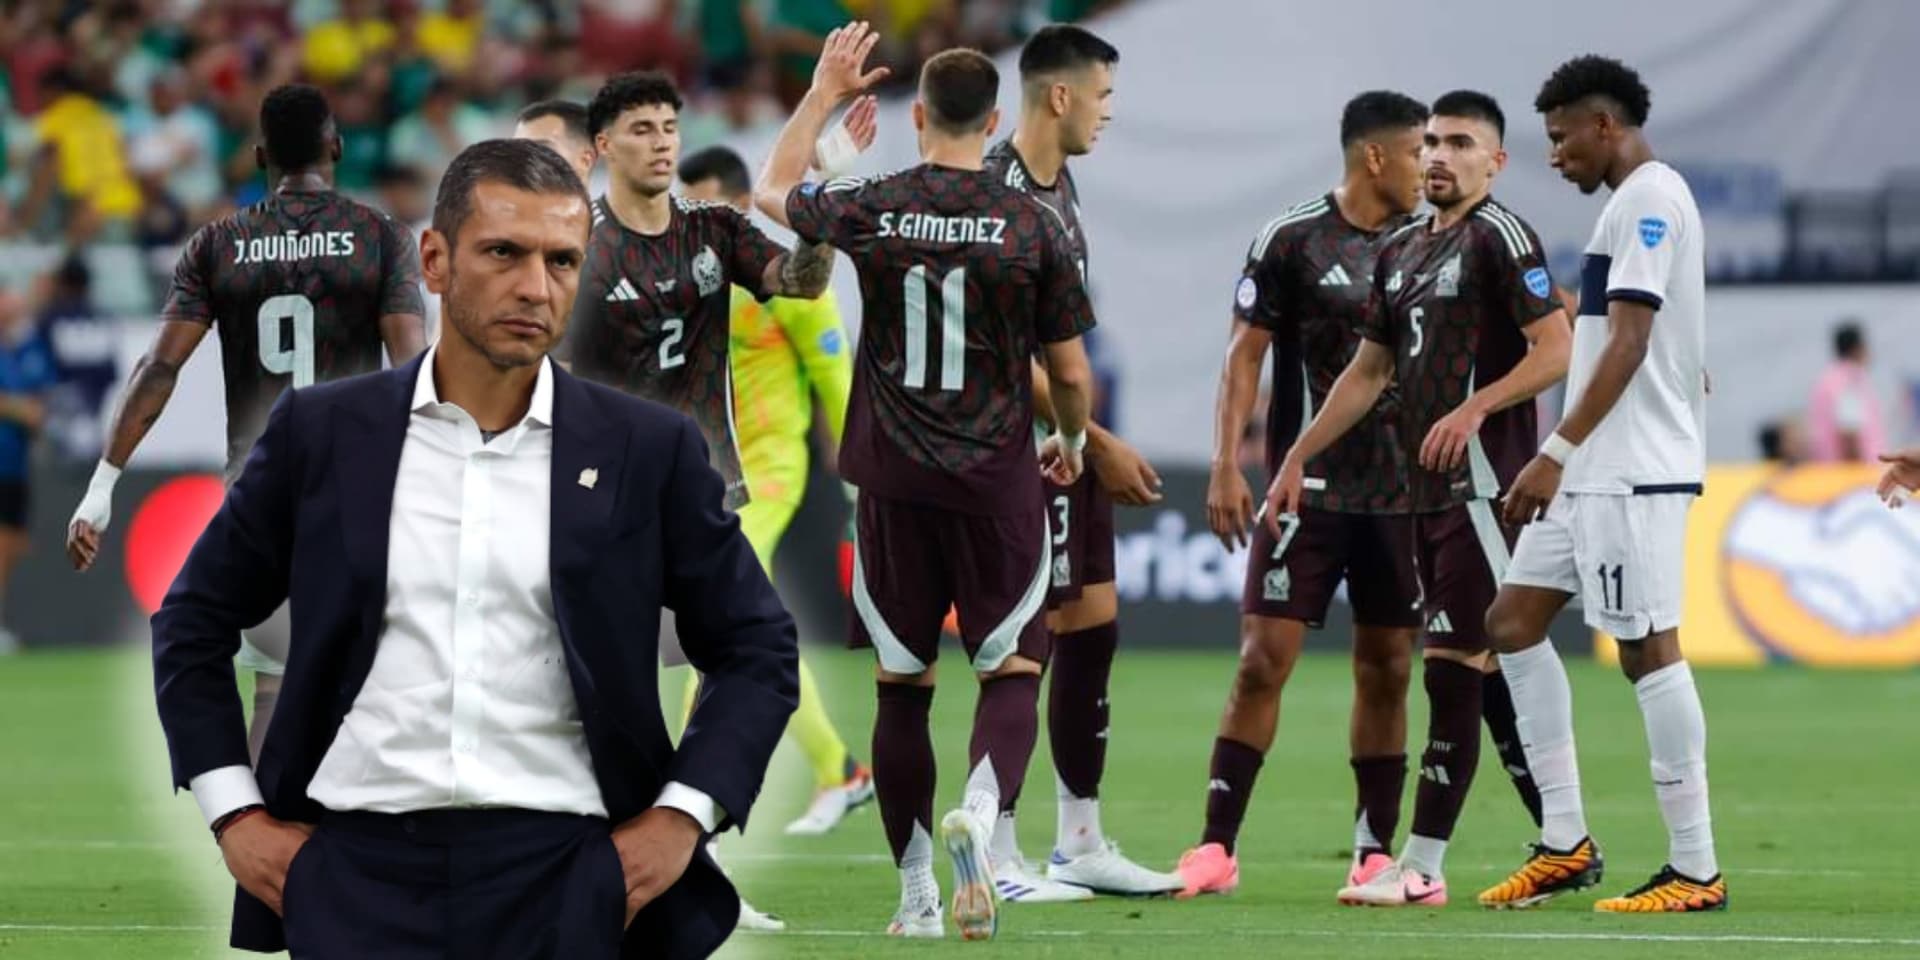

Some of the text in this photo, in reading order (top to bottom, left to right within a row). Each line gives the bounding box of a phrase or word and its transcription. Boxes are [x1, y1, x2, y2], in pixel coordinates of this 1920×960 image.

[877, 212, 1006, 244] S.GIMENEZ
[258, 294, 315, 390] 9
[659, 318, 686, 370] 2
[903, 264, 965, 390] 11
[1409, 306, 1424, 357] 5
[1053, 495, 1069, 545] 3
[1270, 511, 1300, 560] 7
[1598, 562, 1623, 611] 11
